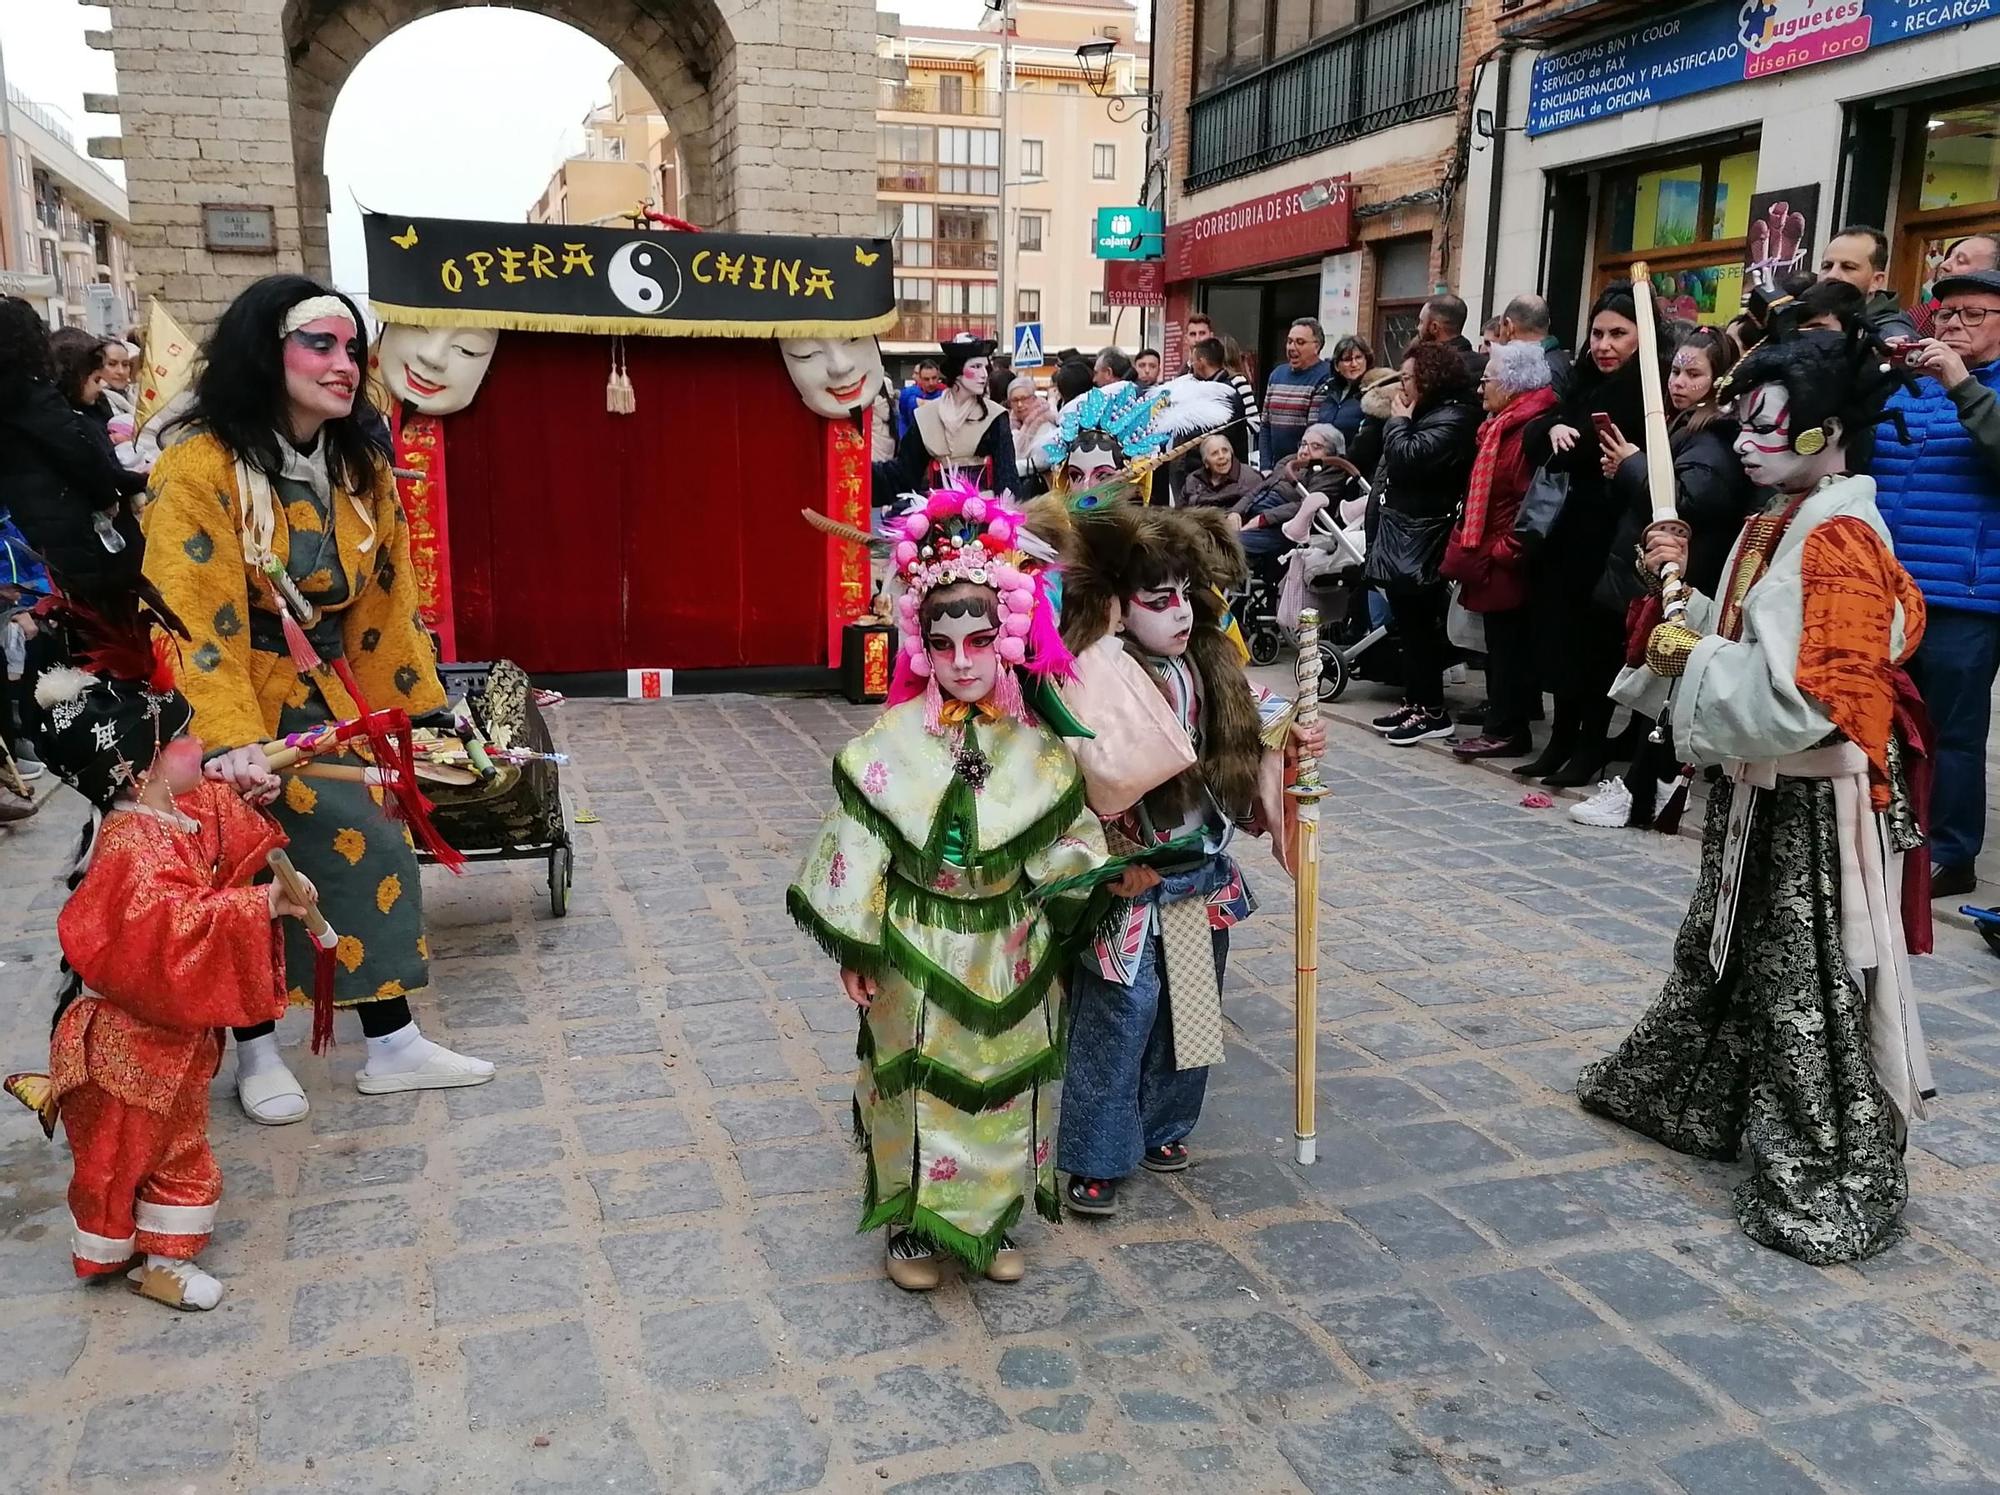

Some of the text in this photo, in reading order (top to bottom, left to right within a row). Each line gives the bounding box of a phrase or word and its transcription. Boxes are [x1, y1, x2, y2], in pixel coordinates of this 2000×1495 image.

[1543, 20, 1680, 75] FOTOCOPIAS B/N Y COLOR
[1749, 34, 1864, 75] diseño toro
[1540, 43, 1738, 111] ENCUADERNACION Y PLASTIFICADO
[1542, 56, 1625, 93] SERVICIO de FAX
[1539, 87, 1651, 129] MATERIAL de OFICINA
[1195, 205, 1263, 240] CORREDURIA
[1267, 198, 1281, 221] DE
[441, 242, 834, 300] OPERA CHINA
[1109, 290, 1164, 299] CORREDURIA
